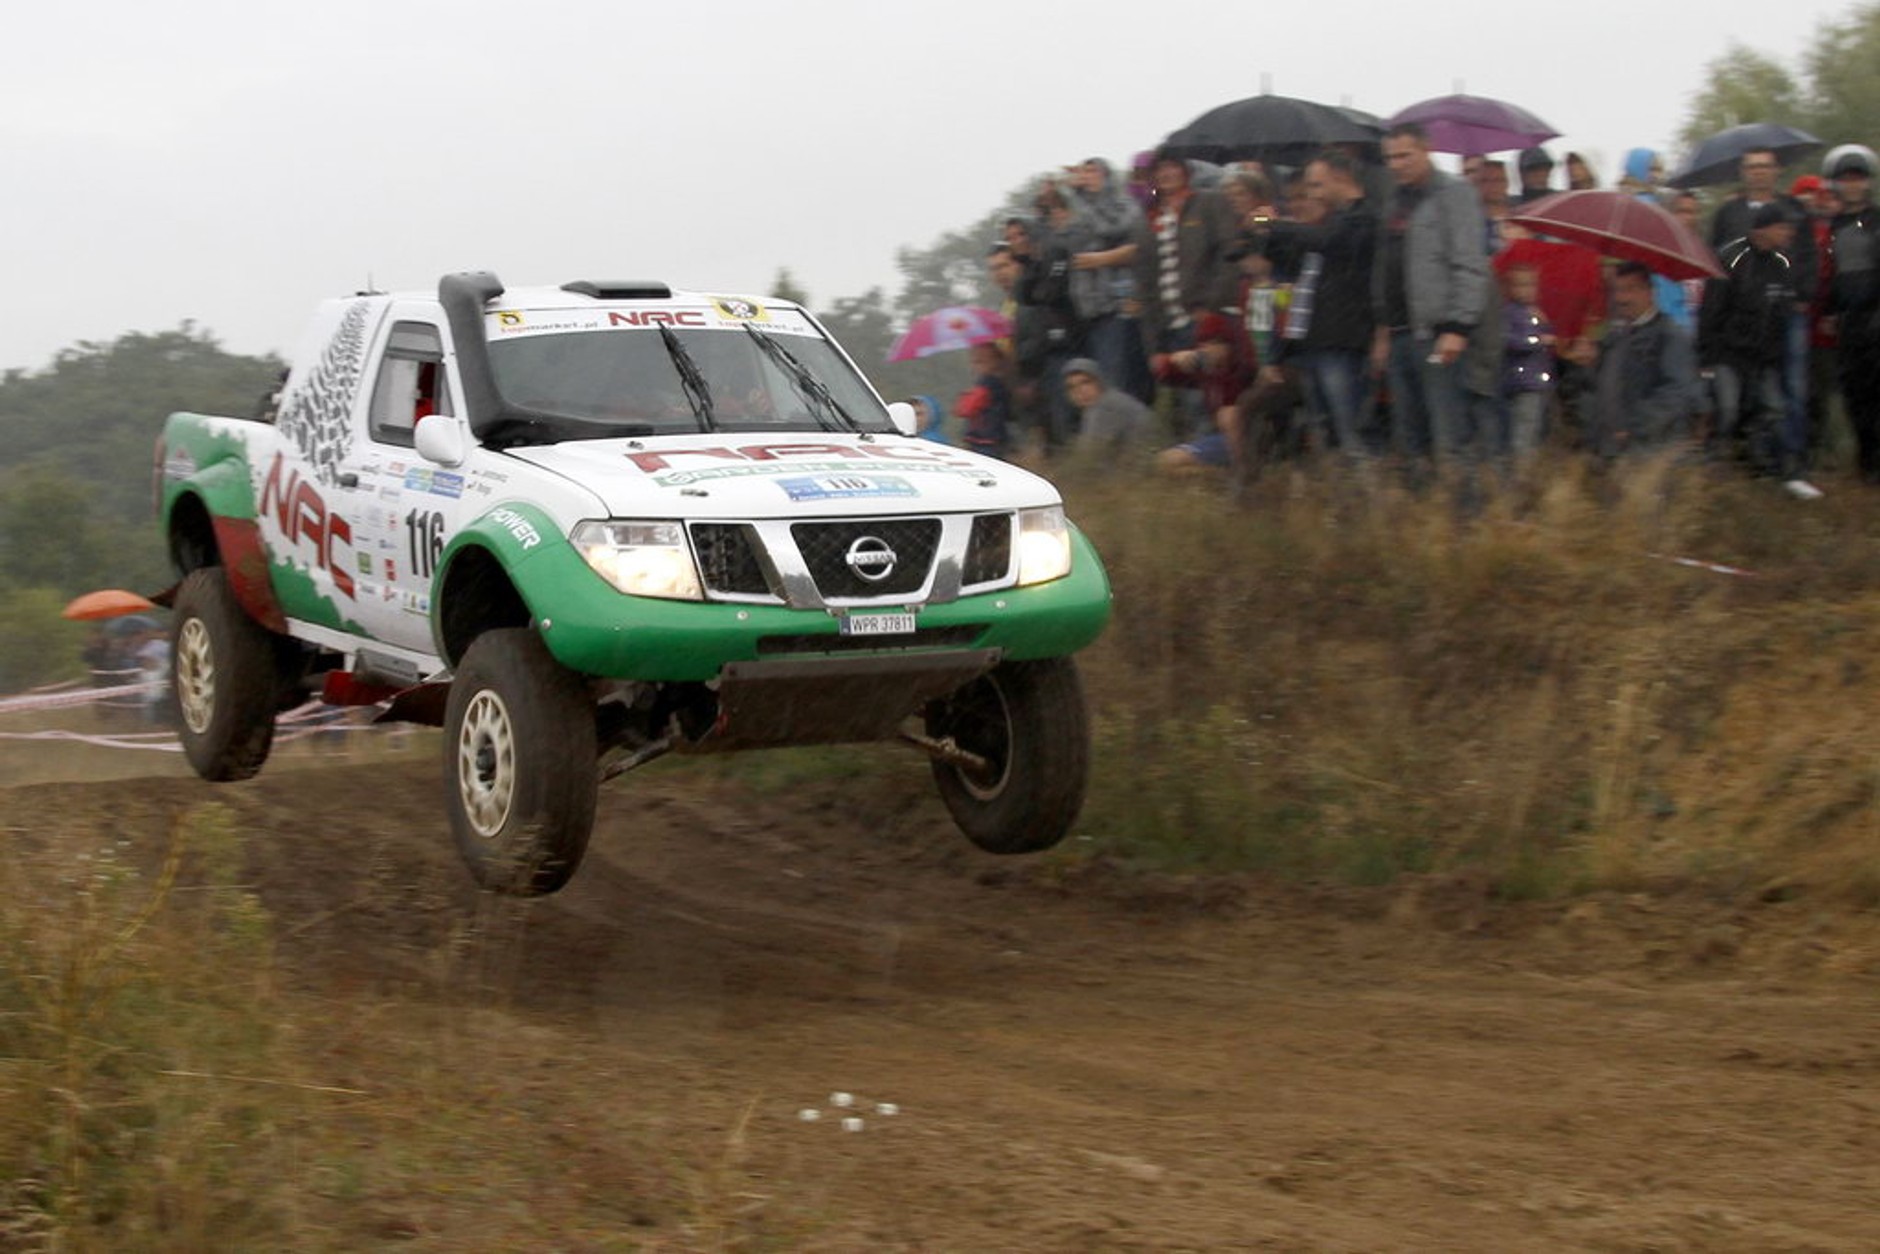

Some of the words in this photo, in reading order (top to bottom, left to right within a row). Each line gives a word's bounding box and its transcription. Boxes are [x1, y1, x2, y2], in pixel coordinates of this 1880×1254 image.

[608, 311, 706, 326] NAC
[826, 477, 868, 490] 116
[259, 450, 357, 602] NAC
[488, 508, 542, 550] POWER
[406, 507, 444, 578] 116
[854, 552, 893, 563] NISSAN
[852, 616, 879, 632] WPR
[881, 614, 913, 631] 37811
